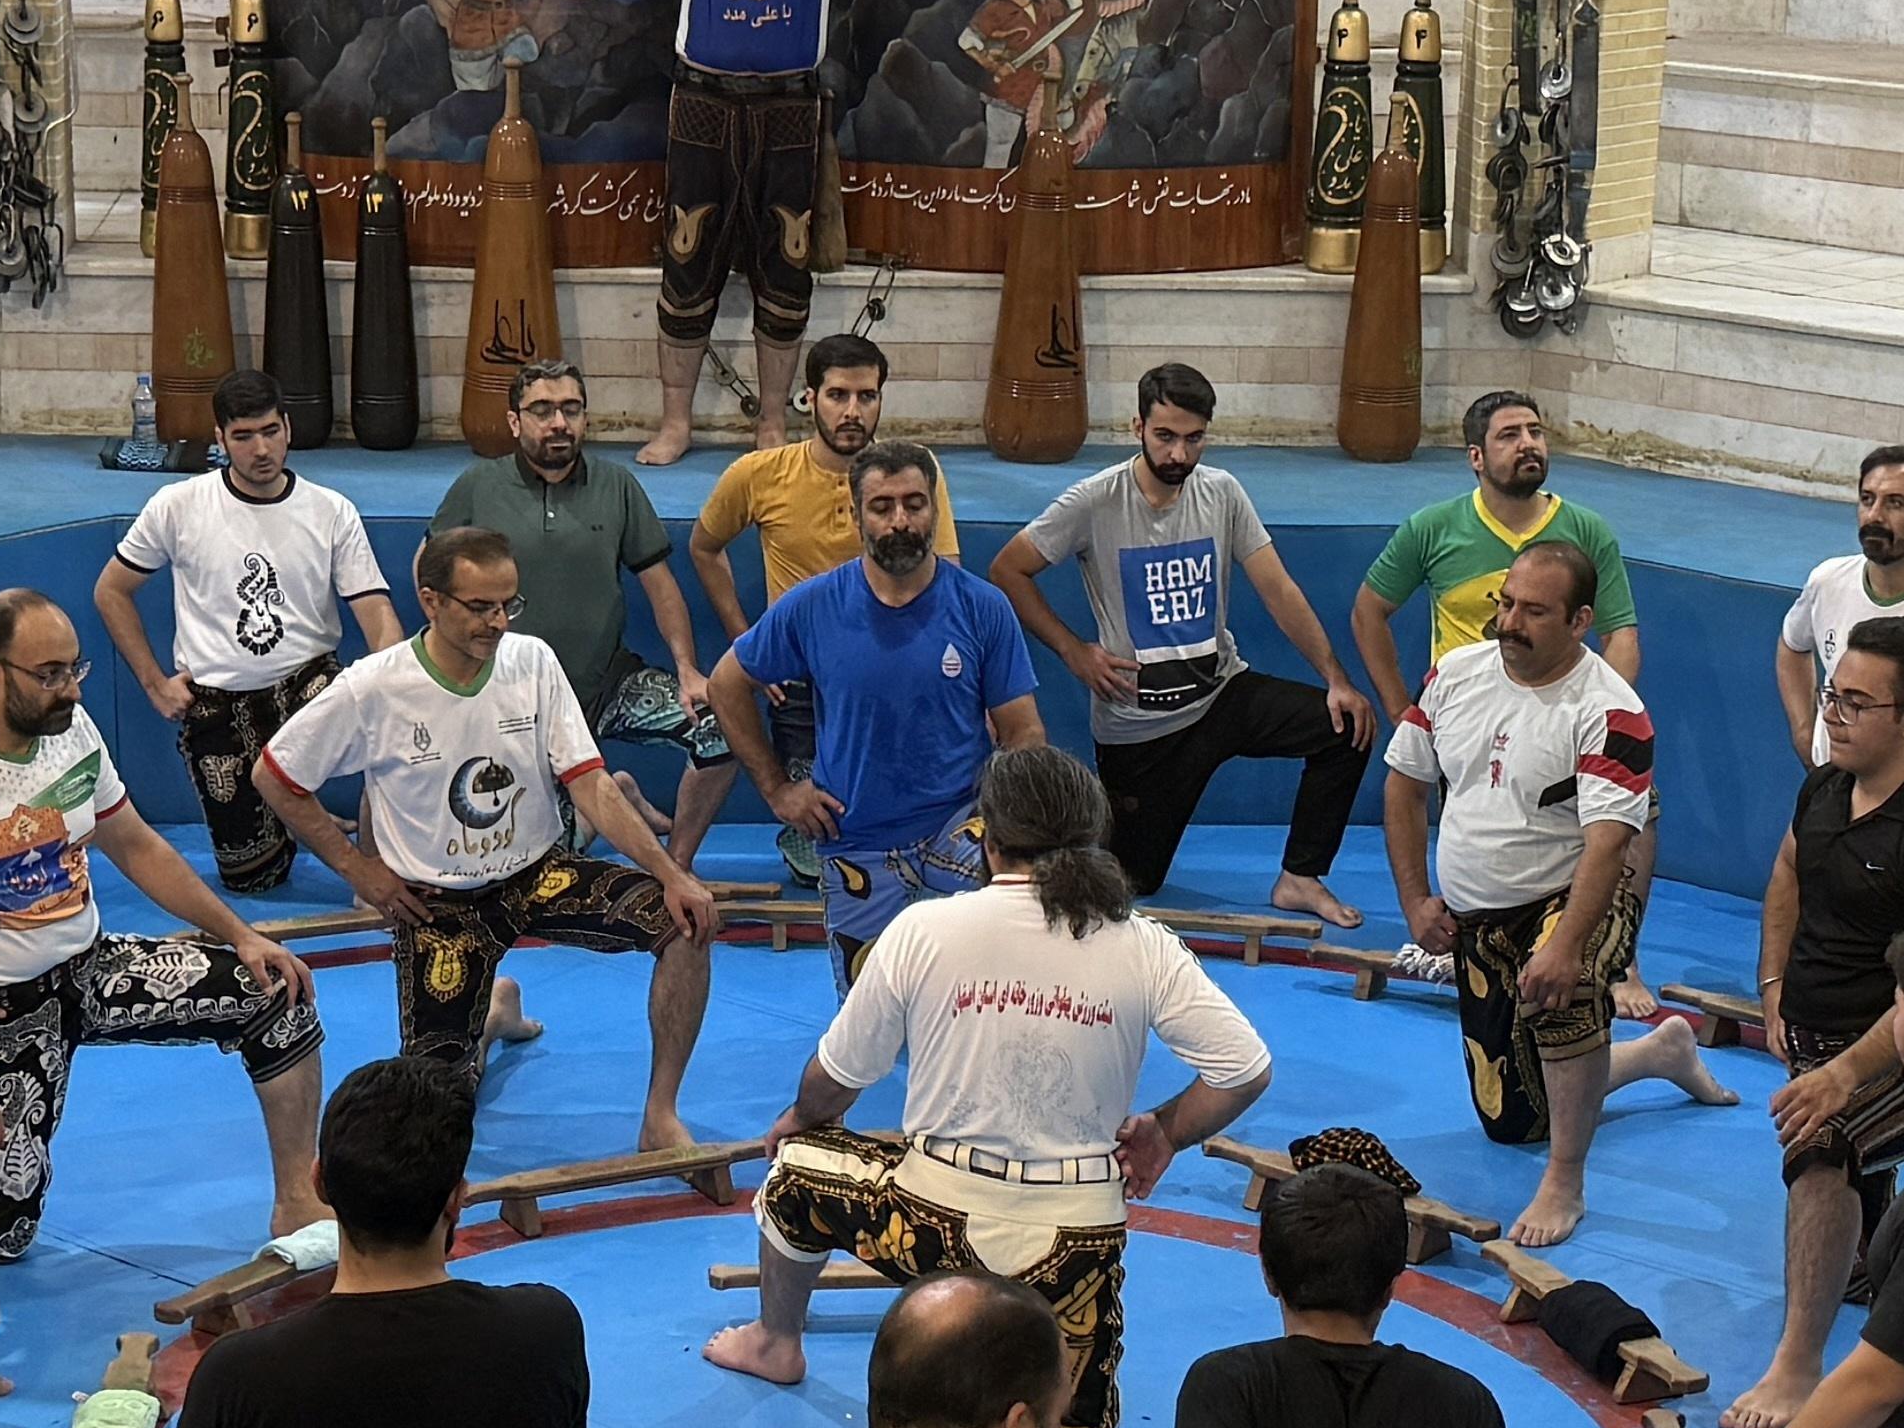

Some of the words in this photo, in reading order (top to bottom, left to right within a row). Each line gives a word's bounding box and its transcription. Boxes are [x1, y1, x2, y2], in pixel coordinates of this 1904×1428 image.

[722, 7, 747, 21] مدد
[750, 4, 779, 28] علی
[782, 3, 793, 26] یا
[1145, 554, 1213, 592] HAM
